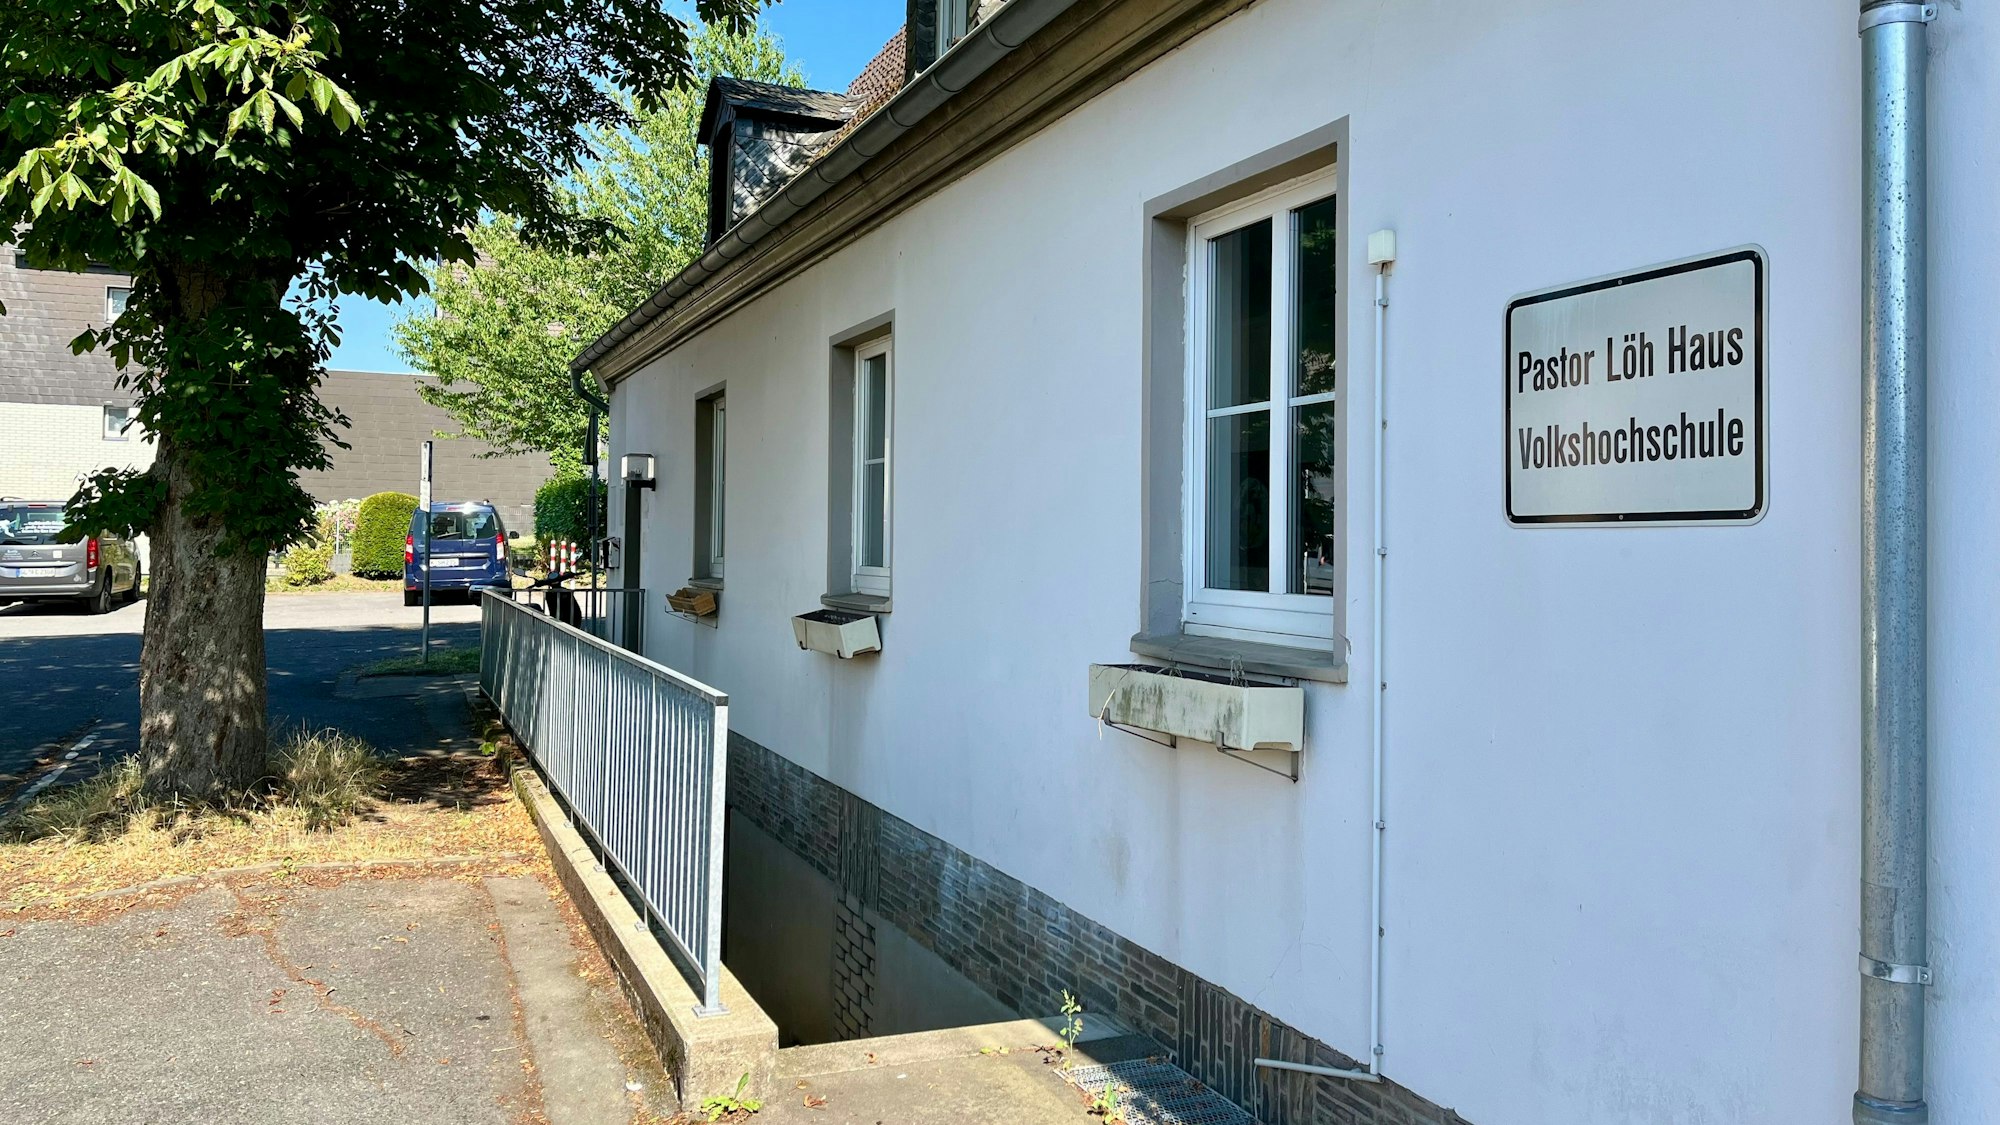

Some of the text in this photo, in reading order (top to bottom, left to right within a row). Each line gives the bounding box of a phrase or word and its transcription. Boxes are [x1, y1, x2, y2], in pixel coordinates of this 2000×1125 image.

[1518, 325, 1744, 394] Pastor Löh Haus
[1518, 408, 1744, 470] Volkshochschule
